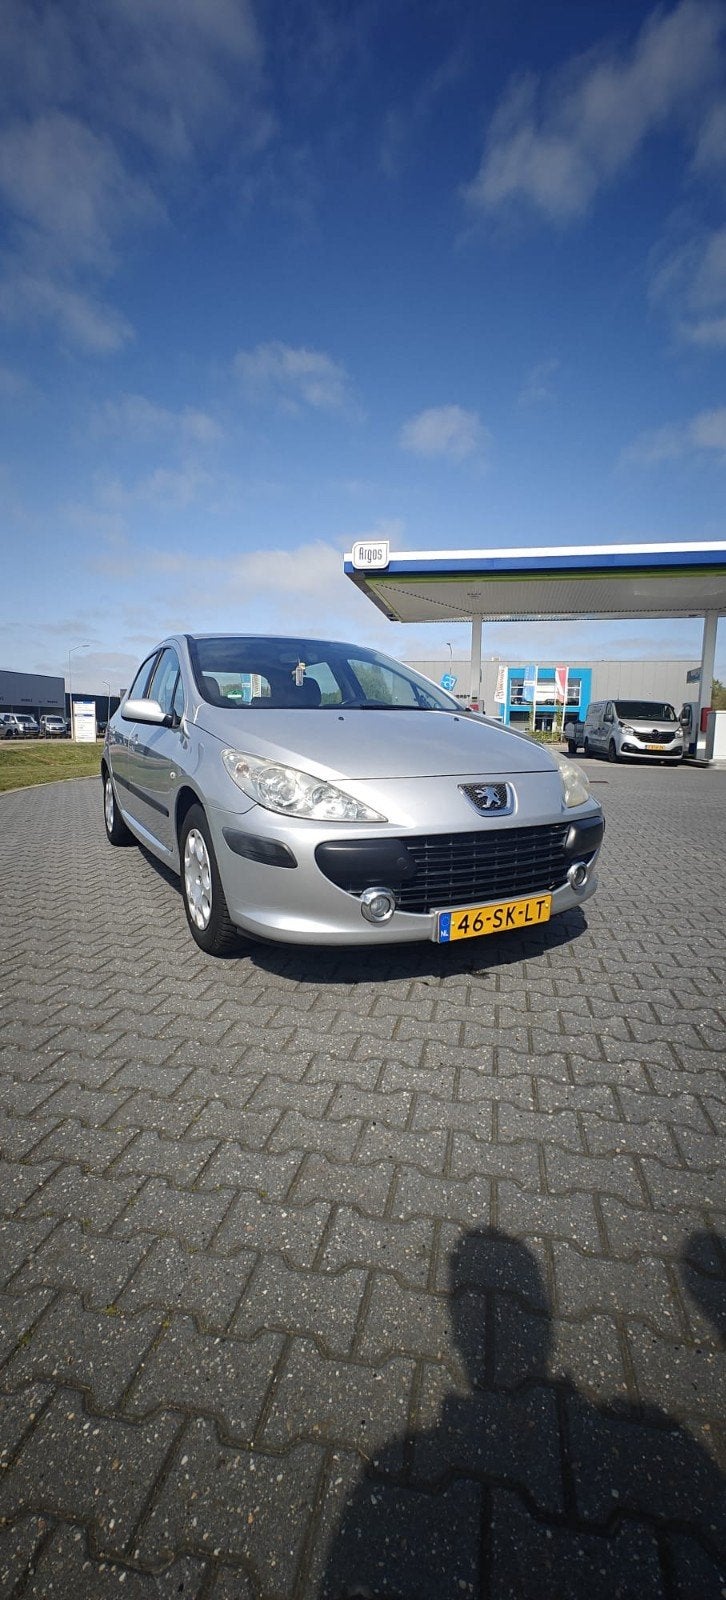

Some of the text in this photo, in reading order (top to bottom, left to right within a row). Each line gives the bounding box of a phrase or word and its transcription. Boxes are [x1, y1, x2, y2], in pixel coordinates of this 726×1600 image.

[358, 546, 383, 564] Argos
[457, 899, 545, 934] 46-SK-LT
[440, 929, 449, 938] NL
